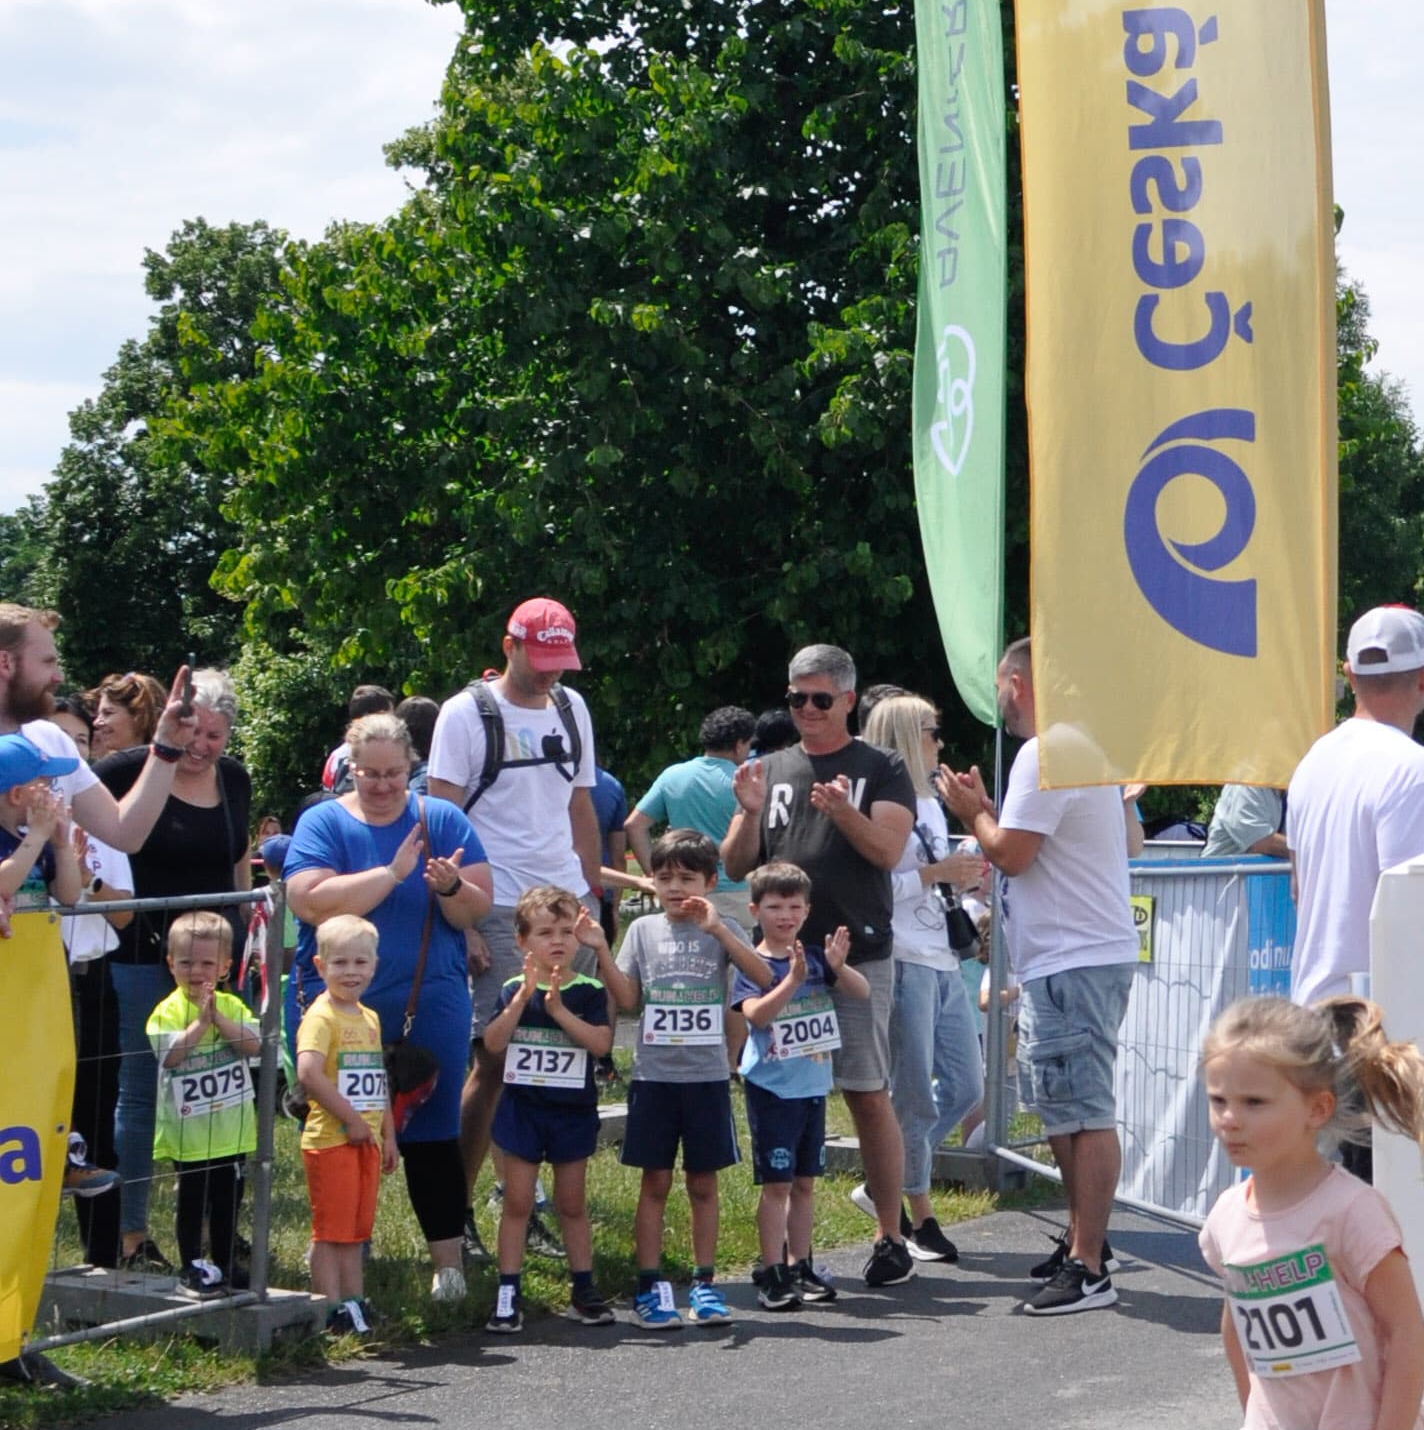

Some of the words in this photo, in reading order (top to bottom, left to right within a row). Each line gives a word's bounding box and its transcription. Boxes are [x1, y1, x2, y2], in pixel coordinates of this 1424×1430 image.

[653, 1008, 712, 1032] 2136
[780, 1015, 835, 1046] 2004
[516, 1048, 576, 1074] 2137
[182, 1065, 246, 1102] 2079
[1237, 1296, 1327, 1350] 2101
